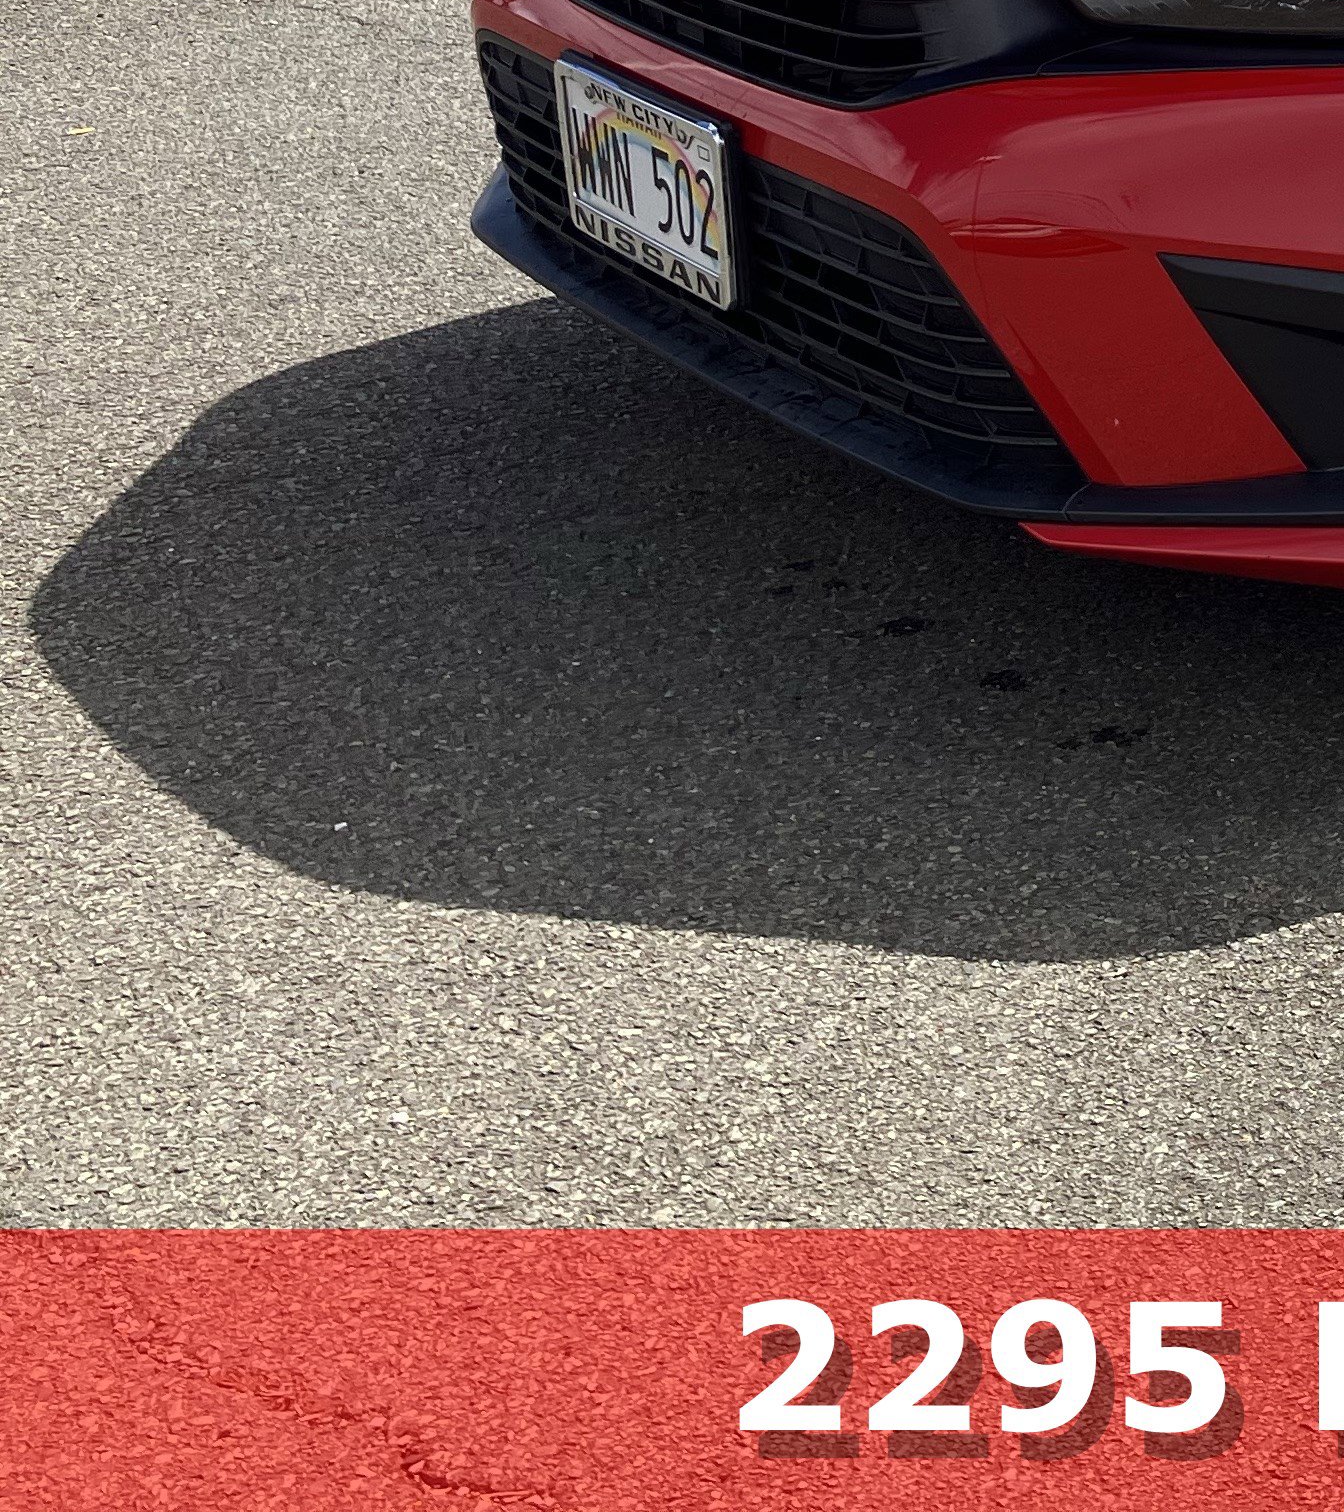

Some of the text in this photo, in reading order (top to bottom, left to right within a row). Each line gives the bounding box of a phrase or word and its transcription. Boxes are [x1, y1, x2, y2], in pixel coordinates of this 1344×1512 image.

[631, 103, 674, 135] CITY
[571, 106, 719, 261] WWN 502
[574, 204, 721, 305] NISSAN
